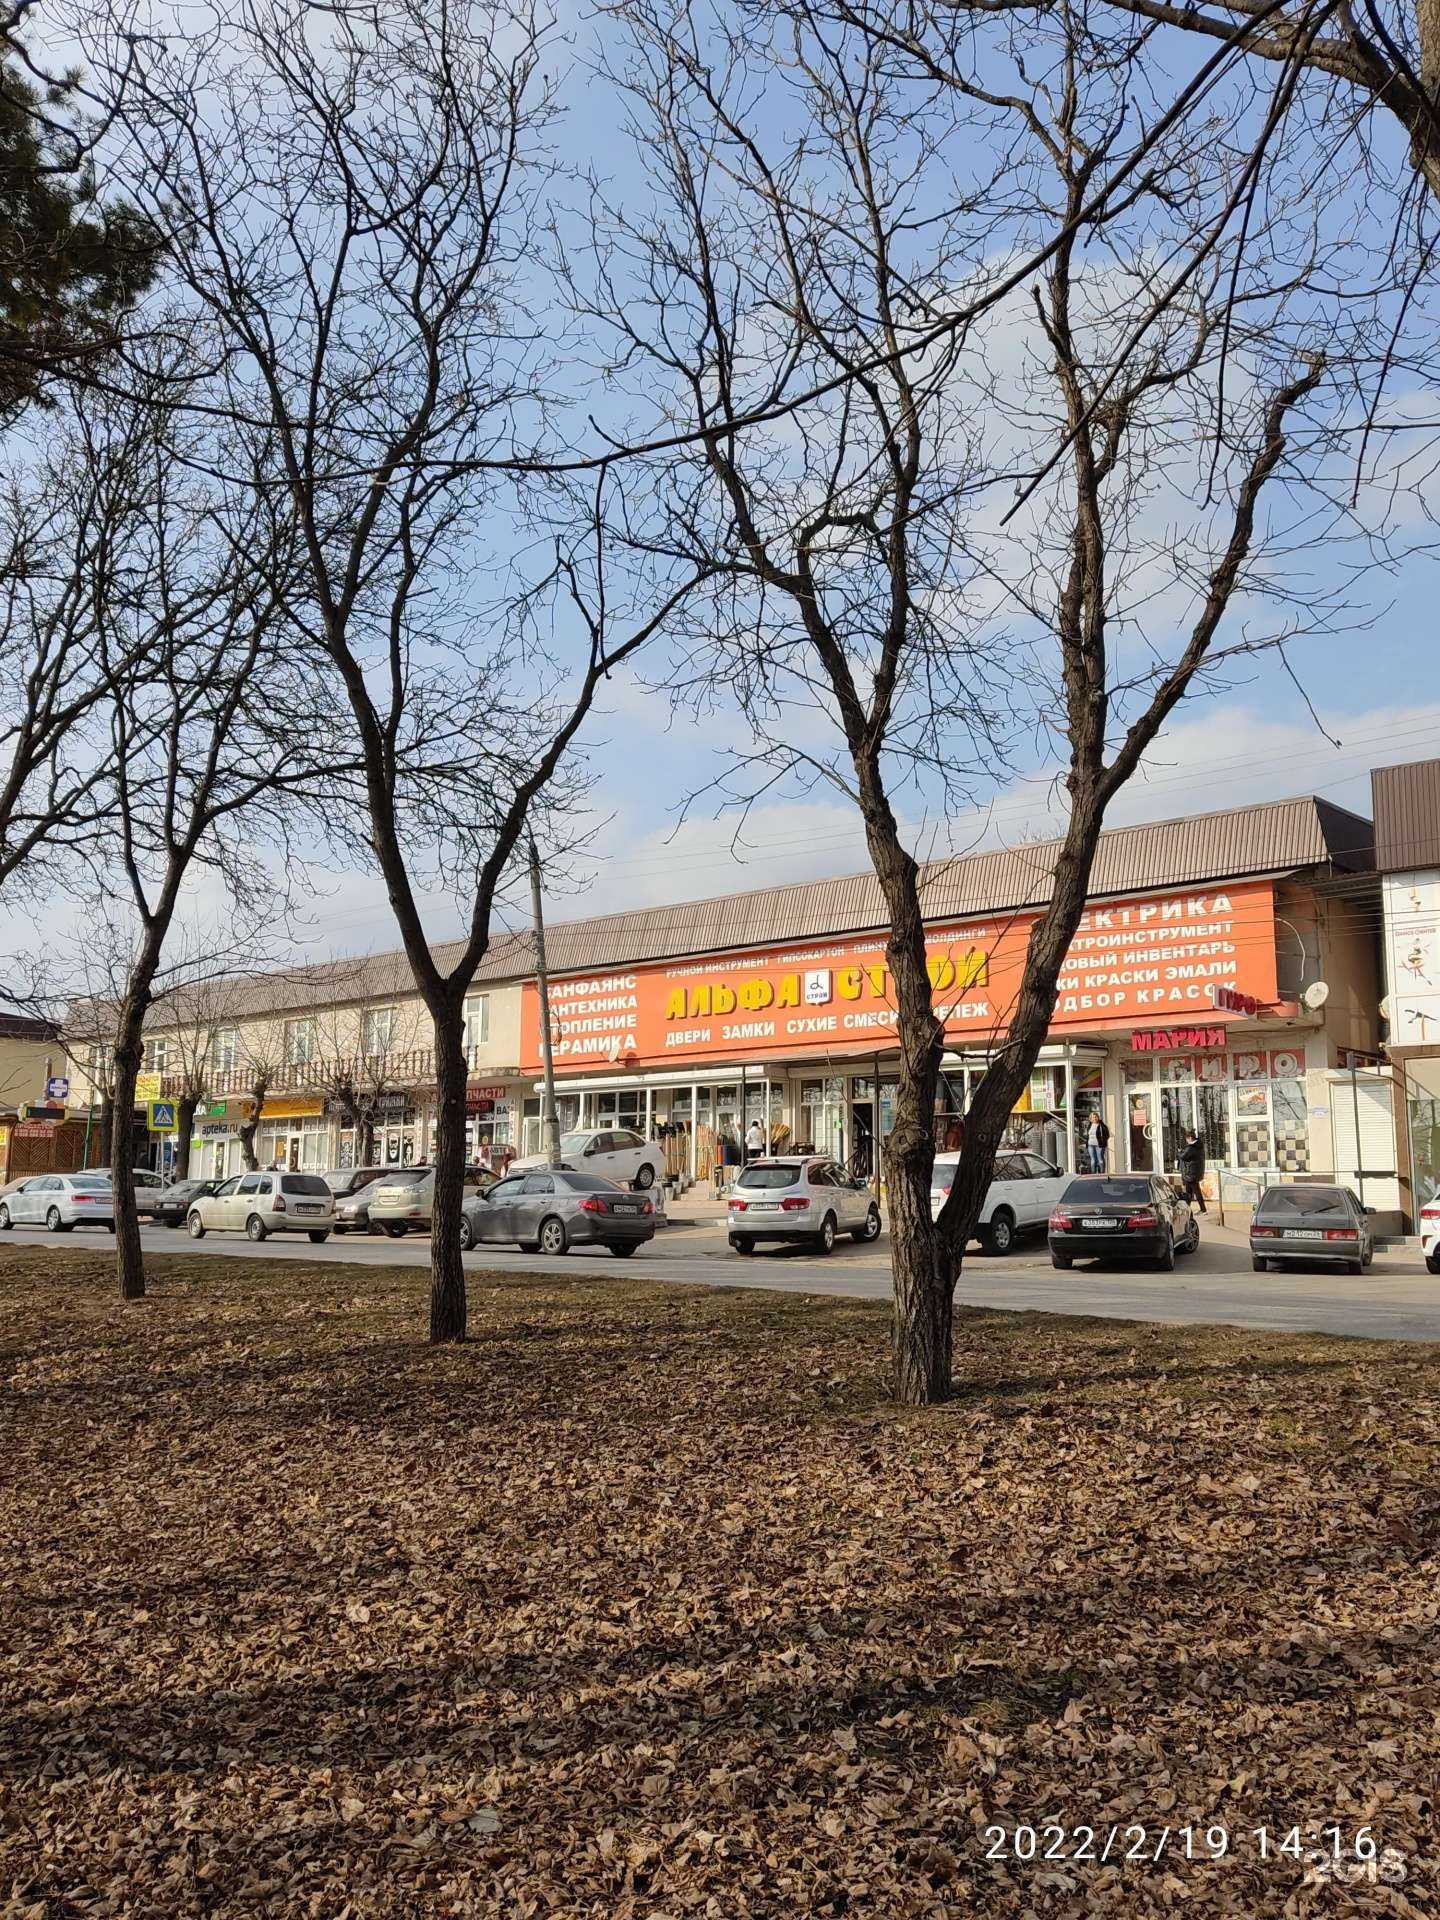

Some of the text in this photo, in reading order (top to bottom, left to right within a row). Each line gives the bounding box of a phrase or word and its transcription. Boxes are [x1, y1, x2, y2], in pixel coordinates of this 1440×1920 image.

[1077, 893, 1233, 931] ЕКТРИКА
[705, 957, 770, 973] ИНСТРУМЕНТ
[777, 945, 845, 964] ГИПСОКАРТОН
[854, 940, 888, 954] ПЛИНТ
[925, 928, 986, 944] МОЛДИНГИ
[1068, 920, 1234, 951] ТРОИНСТРУМЕНТ
[1061, 941, 1236, 973] ОВЫЙ ИНВЕНТАРЬ
[664, 946, 989, 1020] АЛЬФА СТОЙ
[1056, 960, 1237, 991] КИ КРАСКИ ЭМАЛИ
[549, 994, 638, 1017] АНТЕХНИКА
[1055, 991, 1126, 1013] ДБОР
[540, 1014, 637, 1037] ТОПЛЕНИЕ
[665, 1001, 989, 1048] ДВЕРИ ЗАМКИ СУХИЕ СМЕСИ ЕПЕЖ
[1131, 1027, 1226, 1051] МАРИЯ
[466, 1088, 504, 1100] ПЧАСТИ
[202, 1122, 238, 1137] apteka.ru
